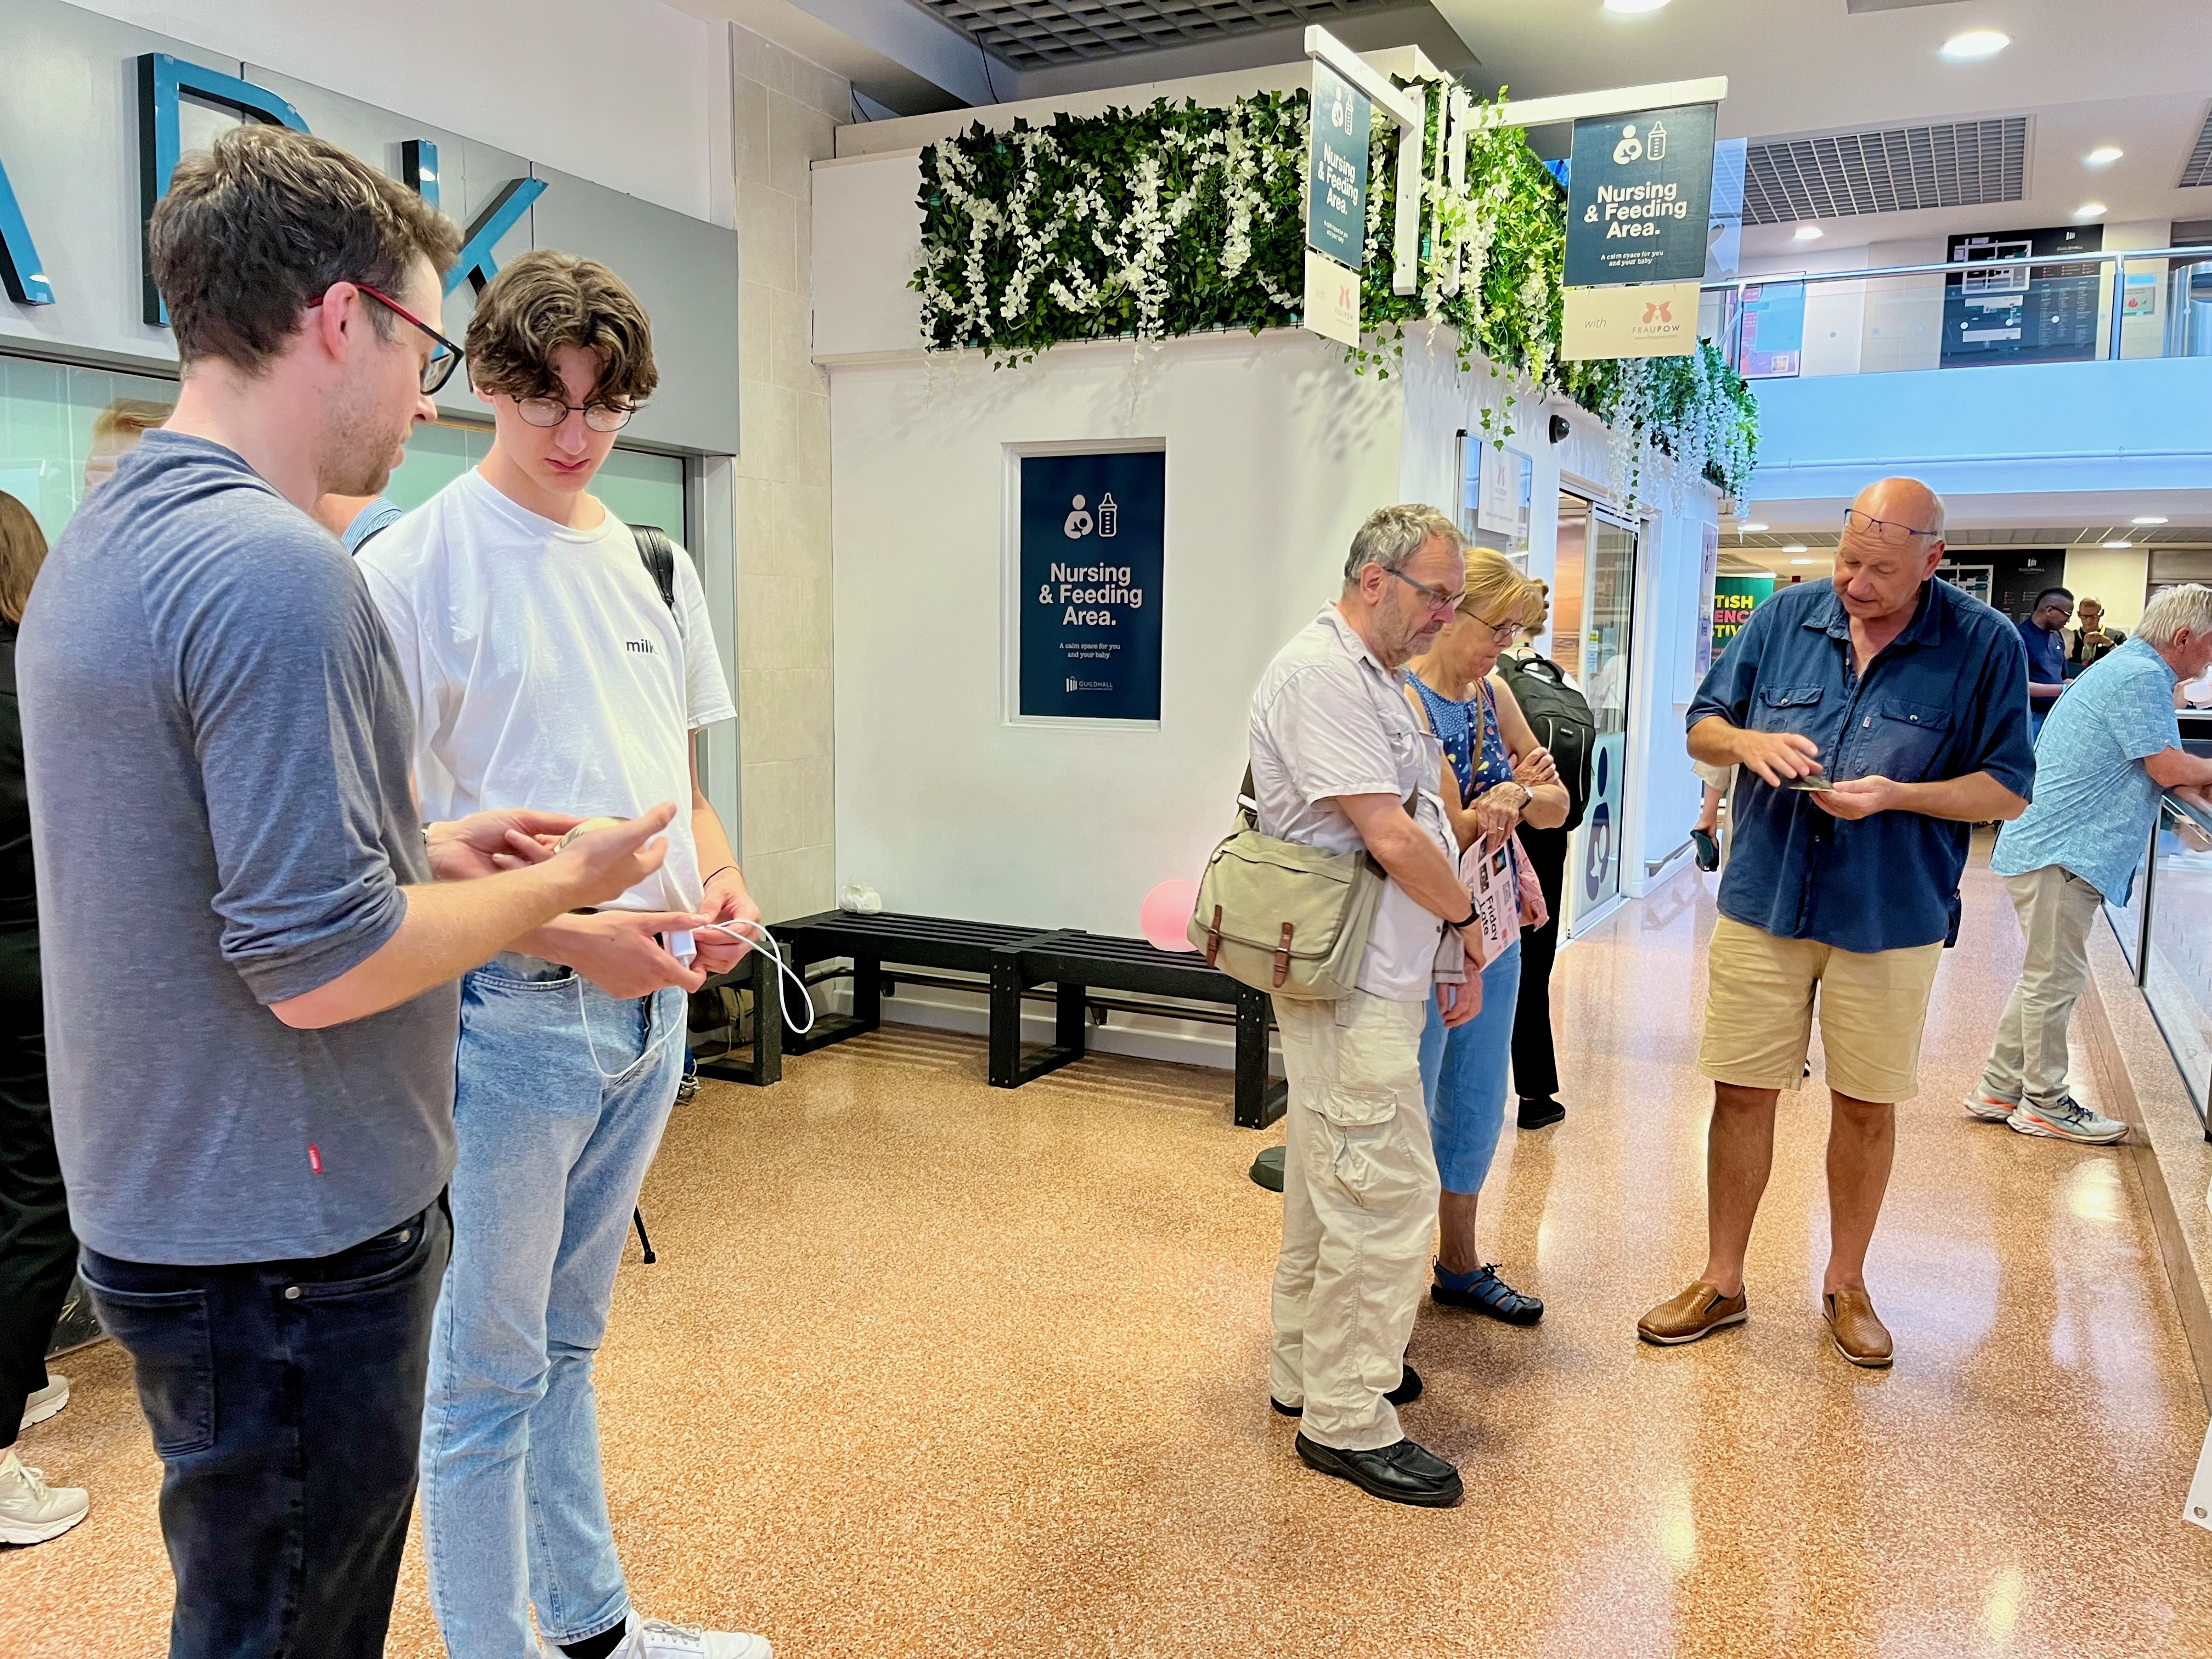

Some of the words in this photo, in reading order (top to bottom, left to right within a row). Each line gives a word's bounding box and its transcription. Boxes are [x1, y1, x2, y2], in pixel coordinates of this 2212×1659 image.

[1324, 143, 1356, 184] Nursing
[1318, 161, 1324, 181] &
[1327, 165, 1358, 206] Feeding
[1597, 181, 1677, 204] Nursing
[1327, 187, 1347, 215] Area.
[1583, 205, 1599, 223] &
[1605, 199, 1688, 221] Feeding
[1606, 221, 1660, 239] Area.
[1621, 258, 1636, 267] your
[1623, 251, 1640, 260] space
[1584, 317, 1606, 329] with
[1632, 325, 1680, 334] FRAUPOW
[1051, 562, 1131, 586] Nursing
[1039, 584, 1053, 604] &
[1060, 584, 1142, 609] Feeding
[1062, 606, 1116, 625] Area.
[1714, 610, 1754, 623] ENC
[626, 639, 659, 655] milk
[1486, 895, 1498, 940] Friday
